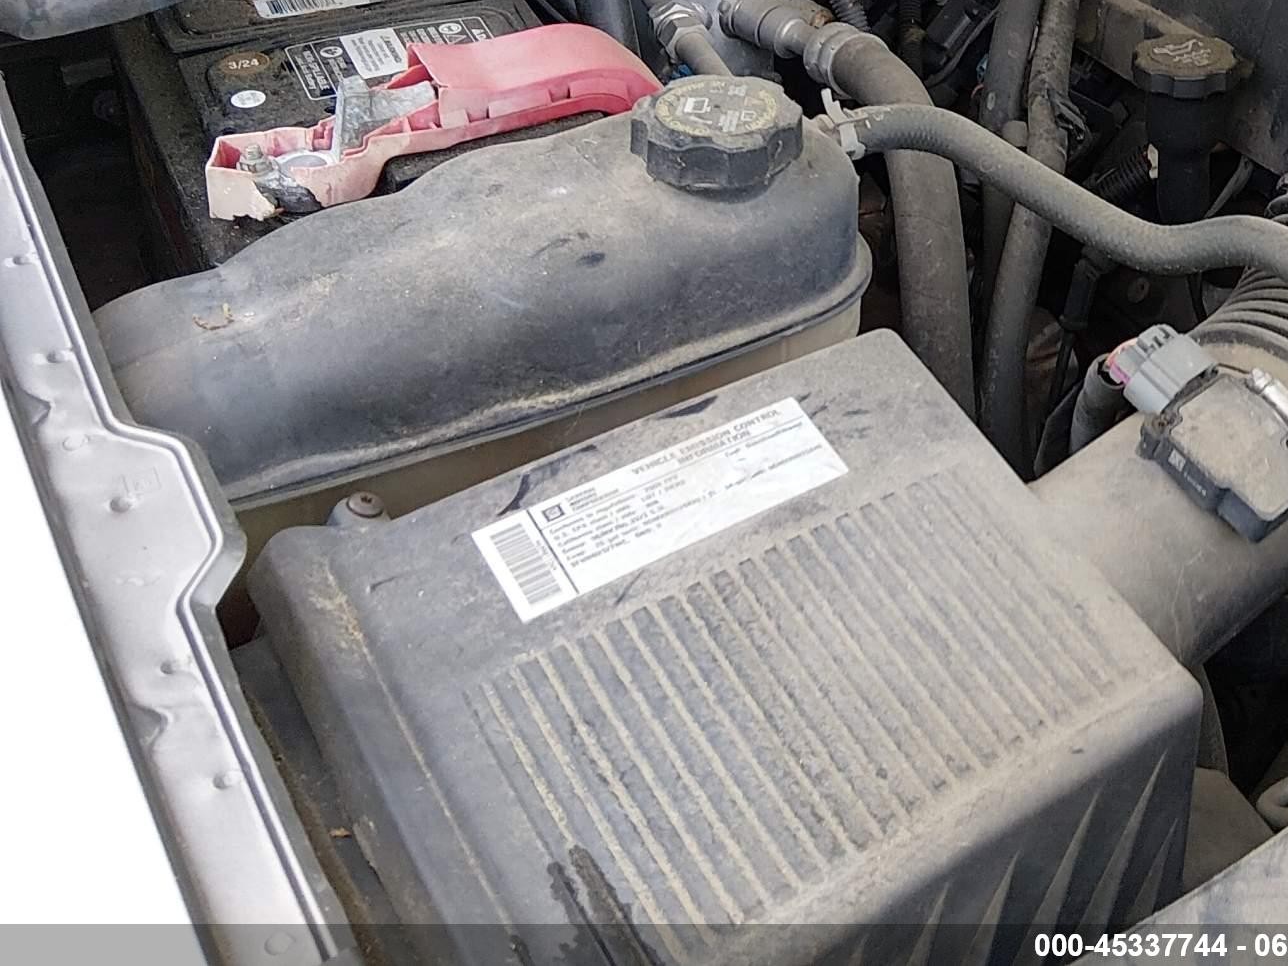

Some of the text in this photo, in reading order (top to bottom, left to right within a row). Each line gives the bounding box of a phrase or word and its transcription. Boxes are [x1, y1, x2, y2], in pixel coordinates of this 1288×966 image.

[228, 58, 259, 70] 3/24
[631, 451, 675, 475] VEHICLE
[680, 428, 731, 455] EMISSION
[733, 408, 781, 432] CONTROL
